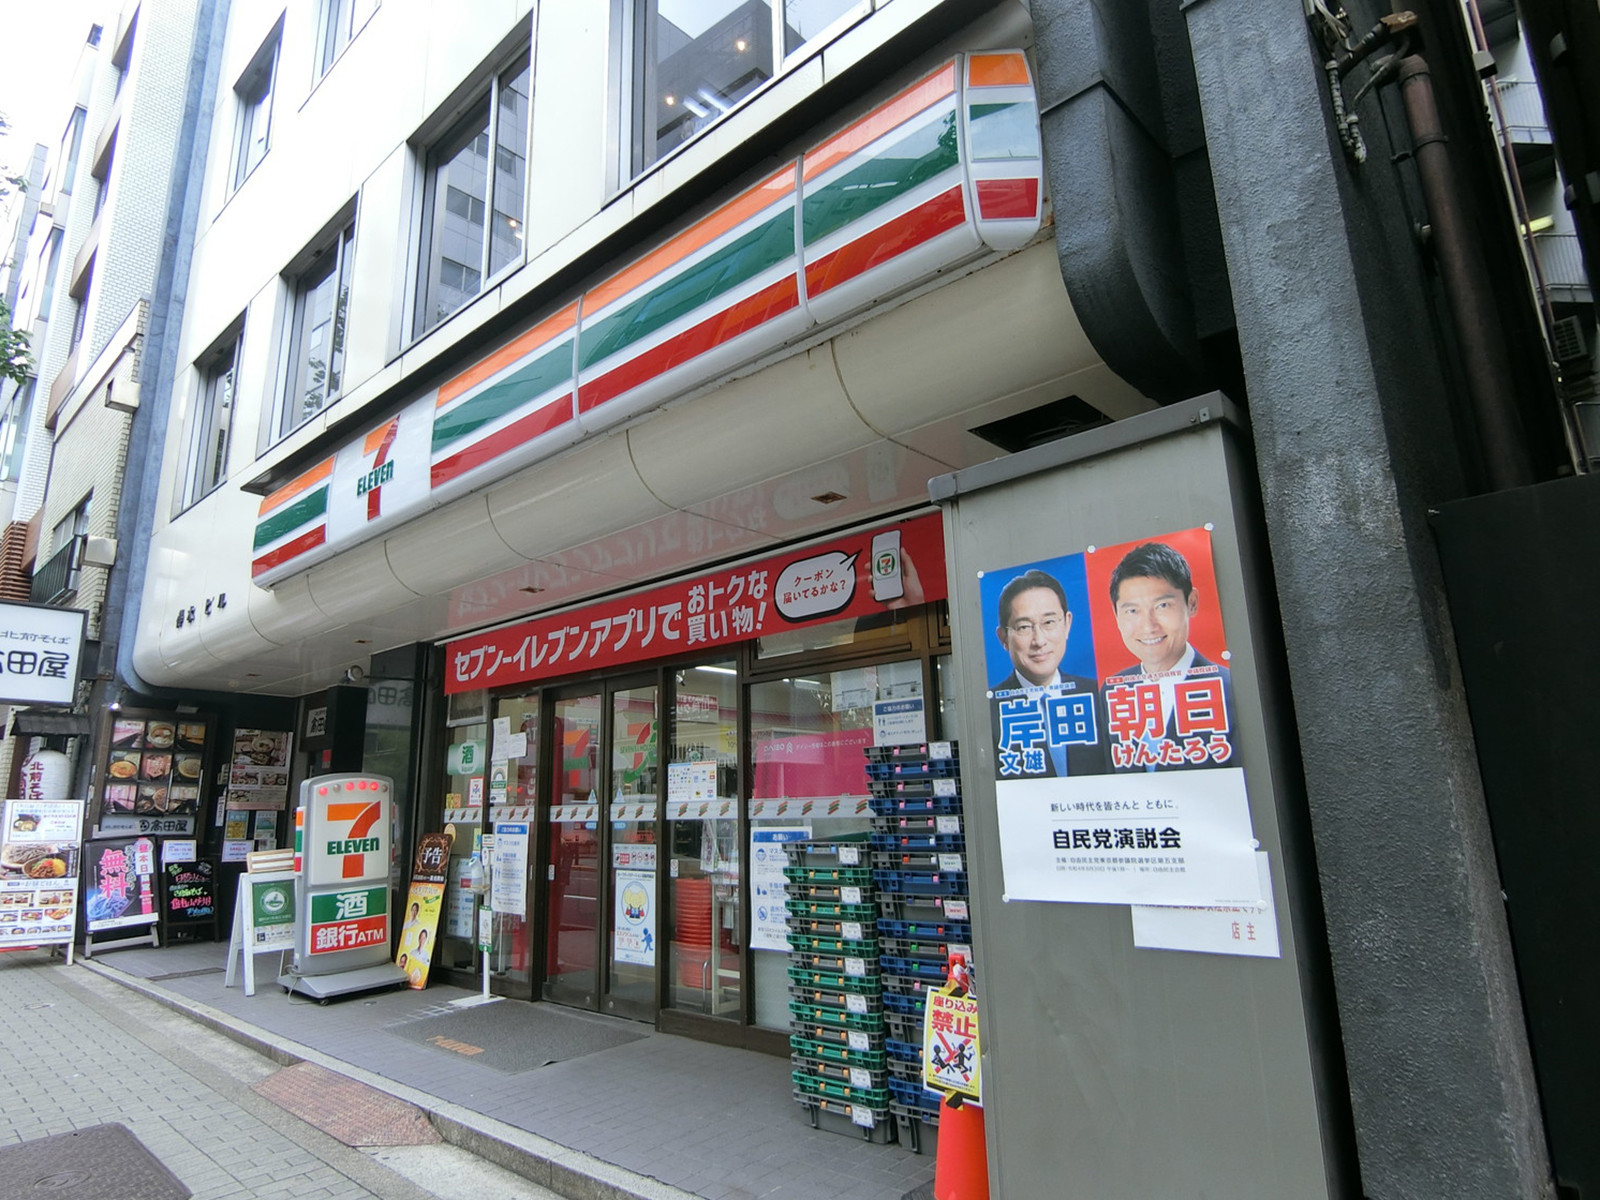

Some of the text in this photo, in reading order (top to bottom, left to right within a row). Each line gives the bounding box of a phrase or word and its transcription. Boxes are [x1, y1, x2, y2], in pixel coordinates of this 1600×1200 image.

[794, 568, 834, 586] クーポン
[687, 570, 768, 614] おトクな
[783, 579, 847, 605] 届いてるかな？
[999, 692, 1098, 751] 岸田
[1106, 676, 1229, 743] 朝日
[461, 745, 474, 765] 酒
[999, 750, 1047, 775] 文雄
[1111, 735, 1232, 768] けんたろう
[1050, 800, 1140, 812] 新しい時代を皆さんと
[150, 819, 188, 832] 高田屋
[1052, 826, 1181, 850] 自民党演説会
[327, 801, 381, 878] 7
[99, 848, 129, 898] 無料
[336, 892, 369, 919] 酒
[315, 923, 384, 950] 銀行ATM
[931, 1009, 977, 1040] 禁止
